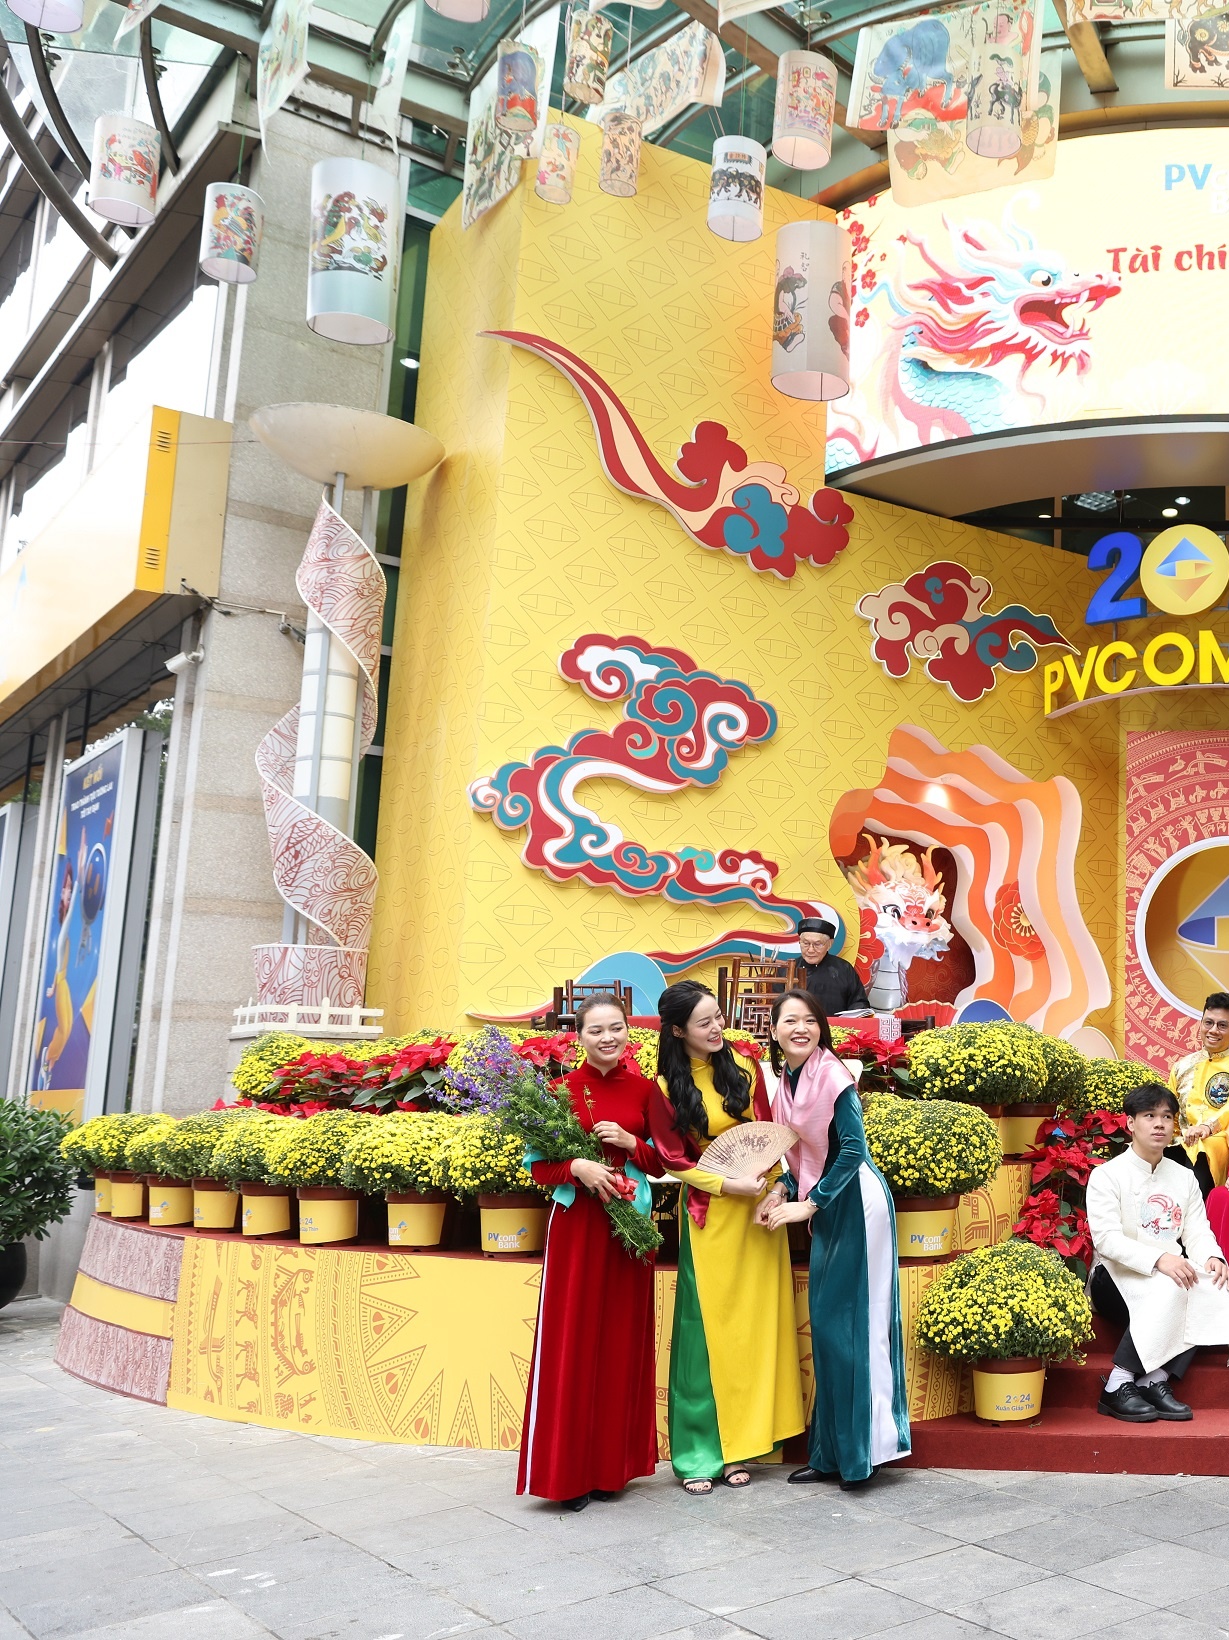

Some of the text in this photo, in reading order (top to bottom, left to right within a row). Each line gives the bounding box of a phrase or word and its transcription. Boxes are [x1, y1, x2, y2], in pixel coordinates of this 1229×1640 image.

[1106, 244, 1163, 274] Tài
[488, 1232, 517, 1242] PVcom
[910, 1234, 941, 1244] PVcom
[498, 1241, 520, 1249] Bank
[923, 1242, 943, 1251] Bank
